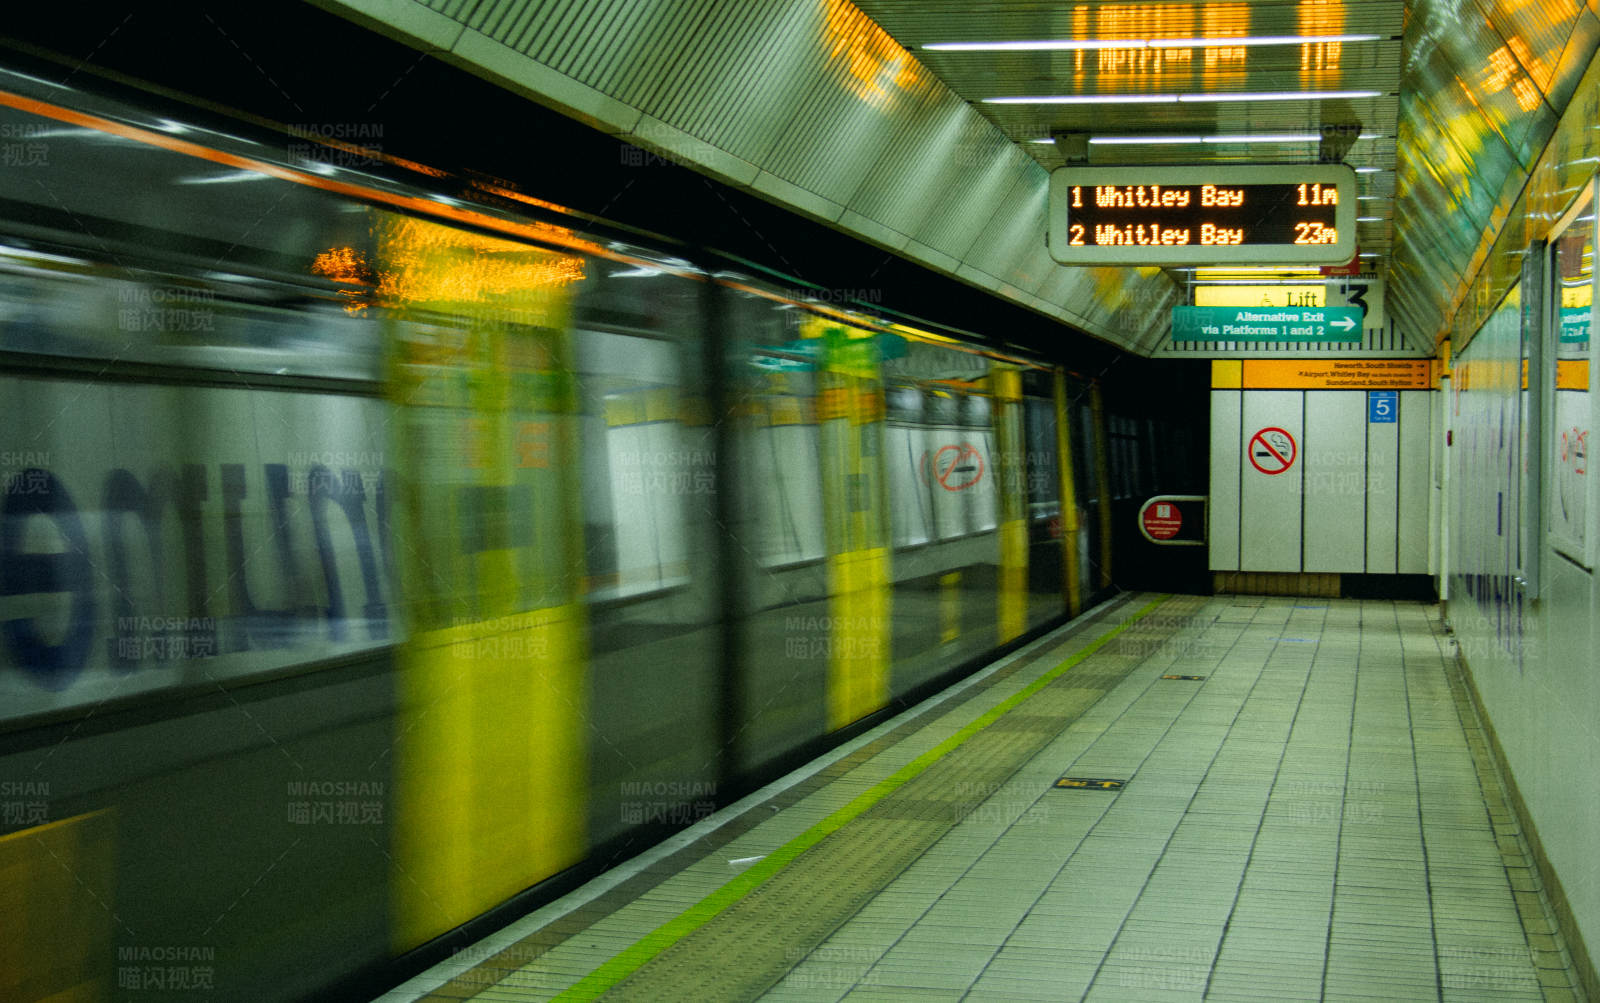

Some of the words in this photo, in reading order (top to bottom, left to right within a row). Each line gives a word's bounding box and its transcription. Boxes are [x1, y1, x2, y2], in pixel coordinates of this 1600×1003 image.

[1071, 185, 1083, 208] 1
[1095, 184, 1190, 208] Whitley
[1200, 184, 1244, 207] Bay
[1296, 183, 1338, 206] 11m
[1070, 224, 1085, 247] 2
[1095, 224, 1190, 247] Whitley
[1200, 223, 1244, 247] Bay
[1294, 222, 1338, 246] 23m
[1286, 291, 1317, 307] Lift
[1340, 284, 1369, 318] 3
[1235, 311, 1299, 323] Alternative
[1302, 311, 1325, 322] Exit
[1201, 325, 1220, 336] via
[1222, 325, 1278, 336] Platforms
[1282, 325, 1287, 336] 1
[1290, 325, 1313, 336] and
[1316, 325, 1325, 336] 2
[1330, 371, 1356, 379] Whitley
[1375, 399, 1390, 416] 5
